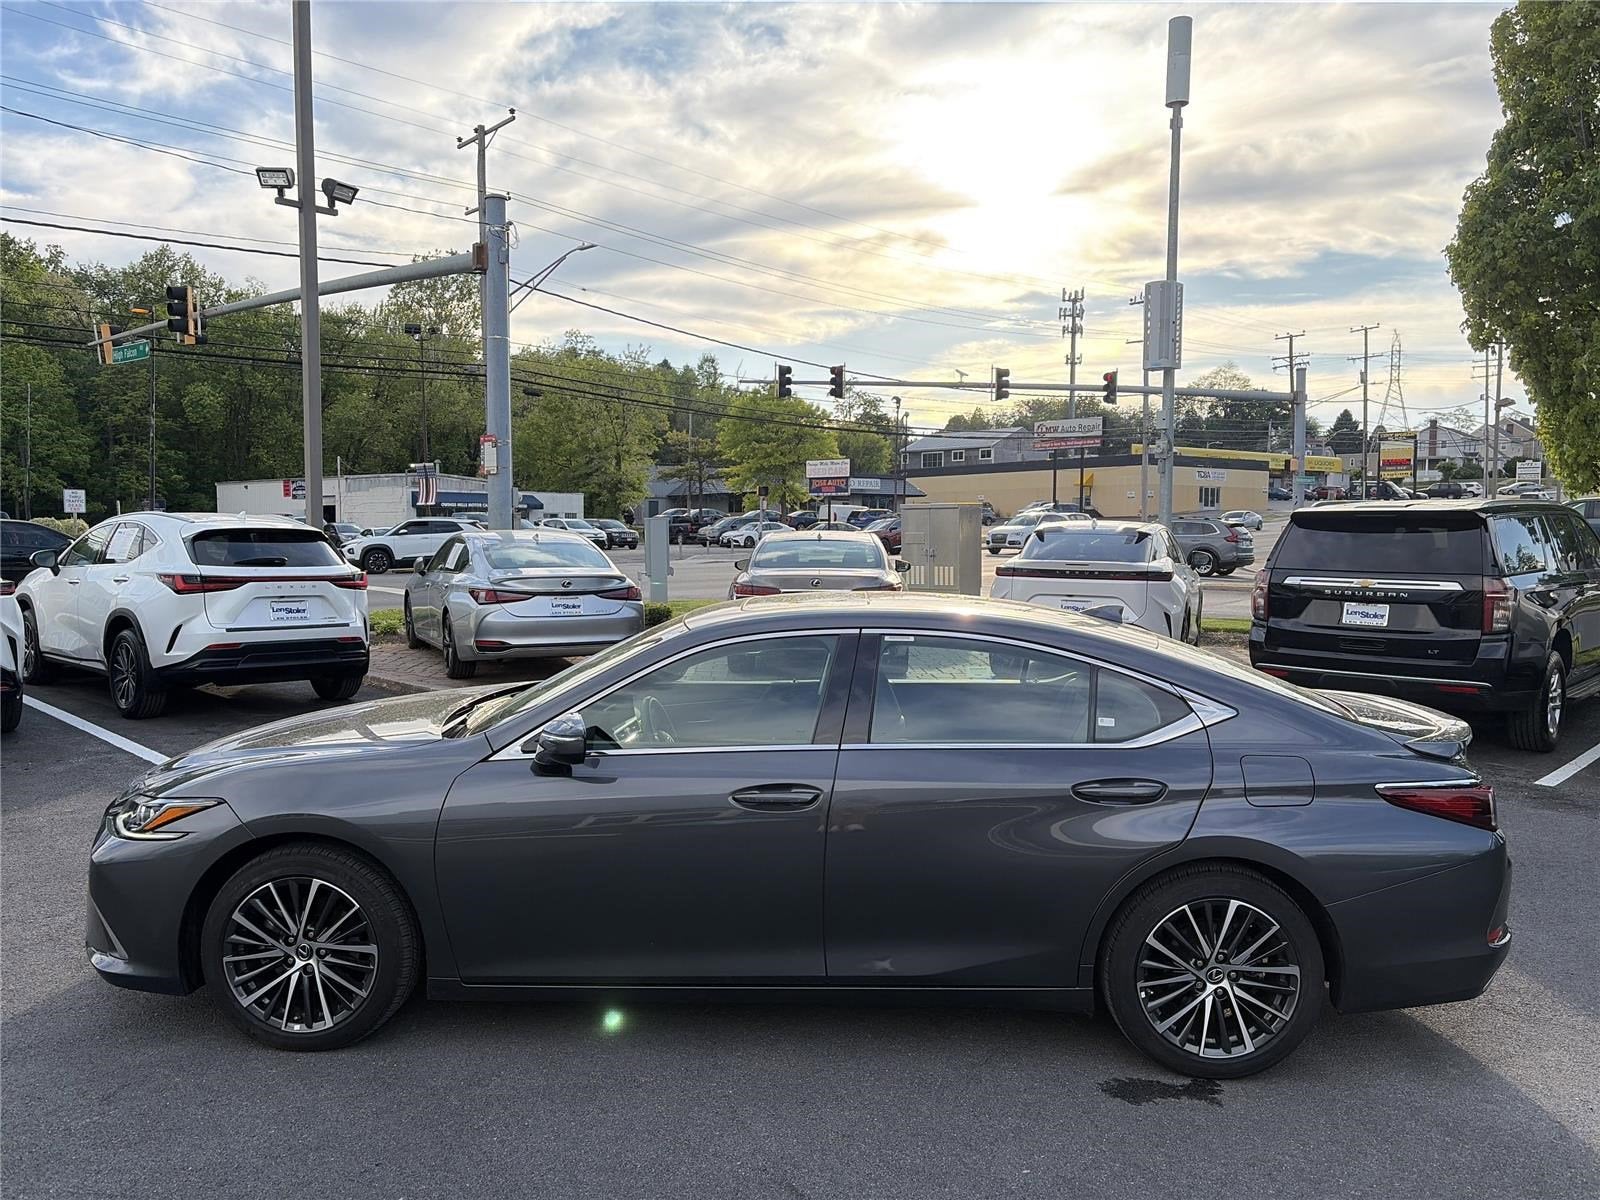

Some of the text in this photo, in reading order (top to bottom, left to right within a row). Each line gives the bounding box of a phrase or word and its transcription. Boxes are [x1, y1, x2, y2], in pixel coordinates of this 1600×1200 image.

[124, 348, 138, 358] Falcon
[1060, 424, 1076, 432] Auto
[1078, 422, 1101, 433] Repair
[857, 479, 880, 488] REPAIR
[1324, 589, 1408, 598] SUBURBAN
